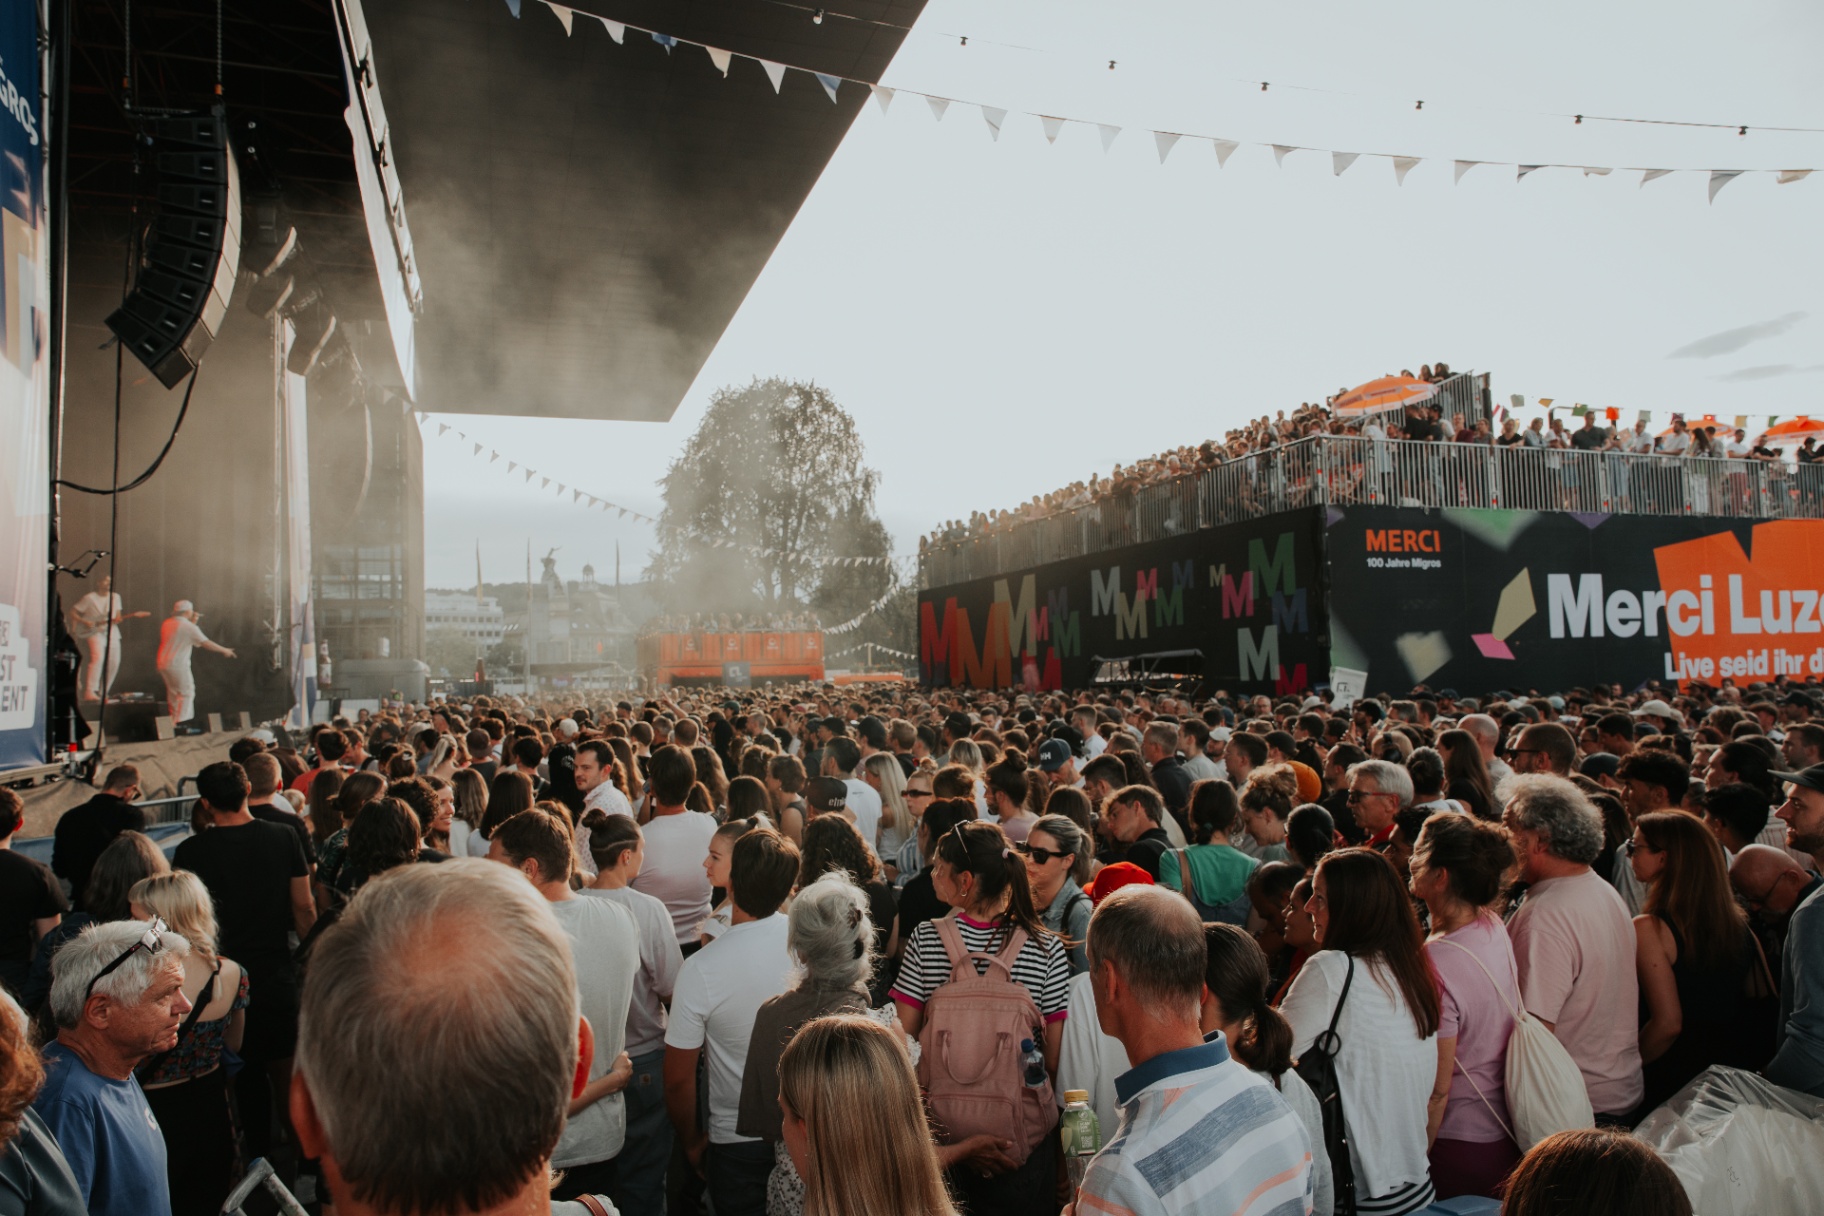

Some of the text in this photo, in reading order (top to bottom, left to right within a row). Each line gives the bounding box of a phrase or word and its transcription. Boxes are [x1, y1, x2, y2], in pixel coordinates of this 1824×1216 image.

[1366, 529, 1441, 552] MERCI
[1137, 568, 1157, 600] M
[1173, 559, 1193, 589] M
[1210, 564, 1226, 587] M
[1249, 532, 1296, 599] M
[1367, 558, 1441, 570] 100 Jahre Migros
[1091, 566, 1120, 616] M
[1156, 585, 1183, 627] M
[1222, 571, 1254, 619] M
[1272, 588, 1308, 634] M
[1547, 573, 1824, 638] Merci Luz
[994, 574, 1037, 658] M
[1030, 606, 1048, 642] M
[1053, 611, 1081, 659] M
[1116, 589, 1148, 640] M
[921, 597, 960, 680] M
[951, 602, 1012, 688] M
[1238, 625, 1280, 681] M
[1276, 664, 1307, 696] M
[1664, 648, 1824, 680] Live seid ihr d
[1040, 752, 1051, 760] HH
